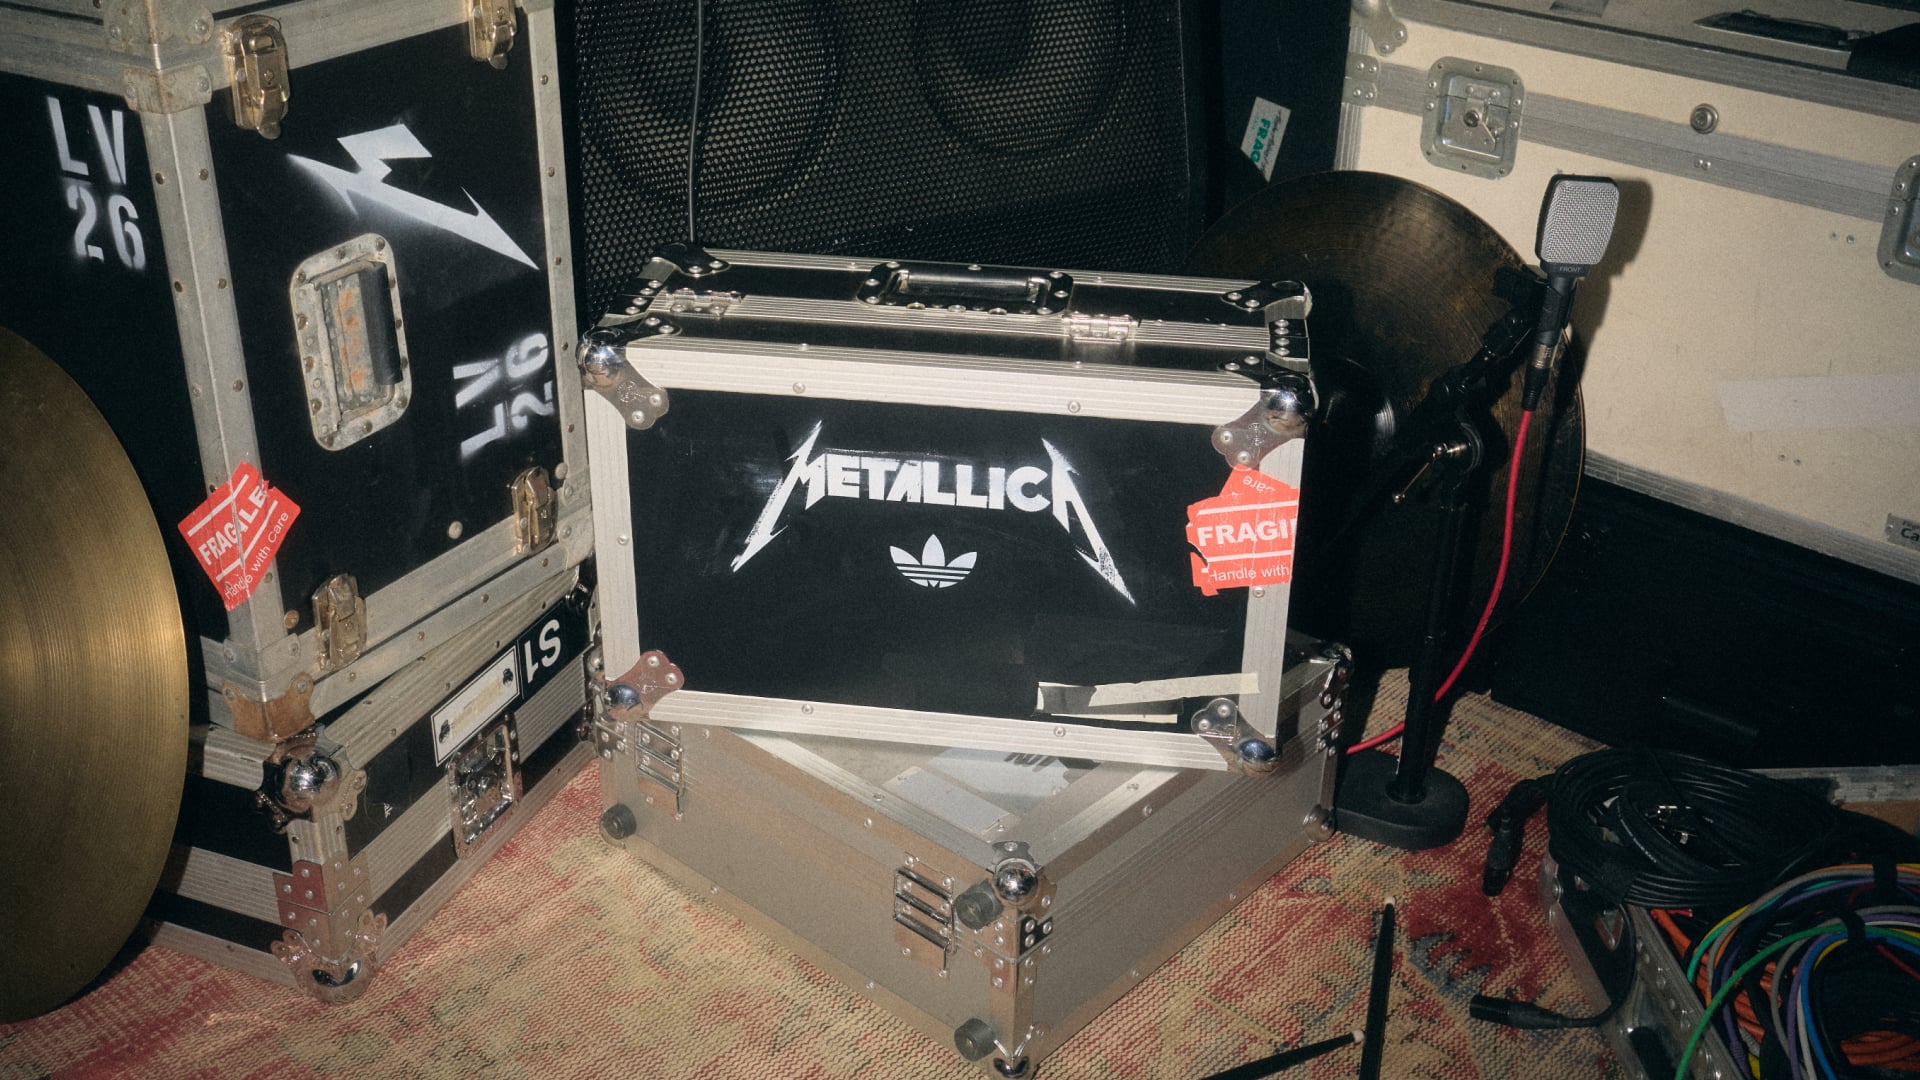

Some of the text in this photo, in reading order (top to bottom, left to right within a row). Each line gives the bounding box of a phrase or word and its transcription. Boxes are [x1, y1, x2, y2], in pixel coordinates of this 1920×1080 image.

[47, 96, 127, 185] LV
[1250, 118, 1271, 163] FRAG
[67, 184, 146, 271] 26
[453, 358, 505, 459] LV
[505, 333, 554, 429] 26
[199, 485, 268, 566] FRAGILE
[251, 546, 271, 572] with
[267, 512, 289, 544] Care
[730, 420, 1136, 605] METALLICA
[1260, 564, 1290, 578] with
